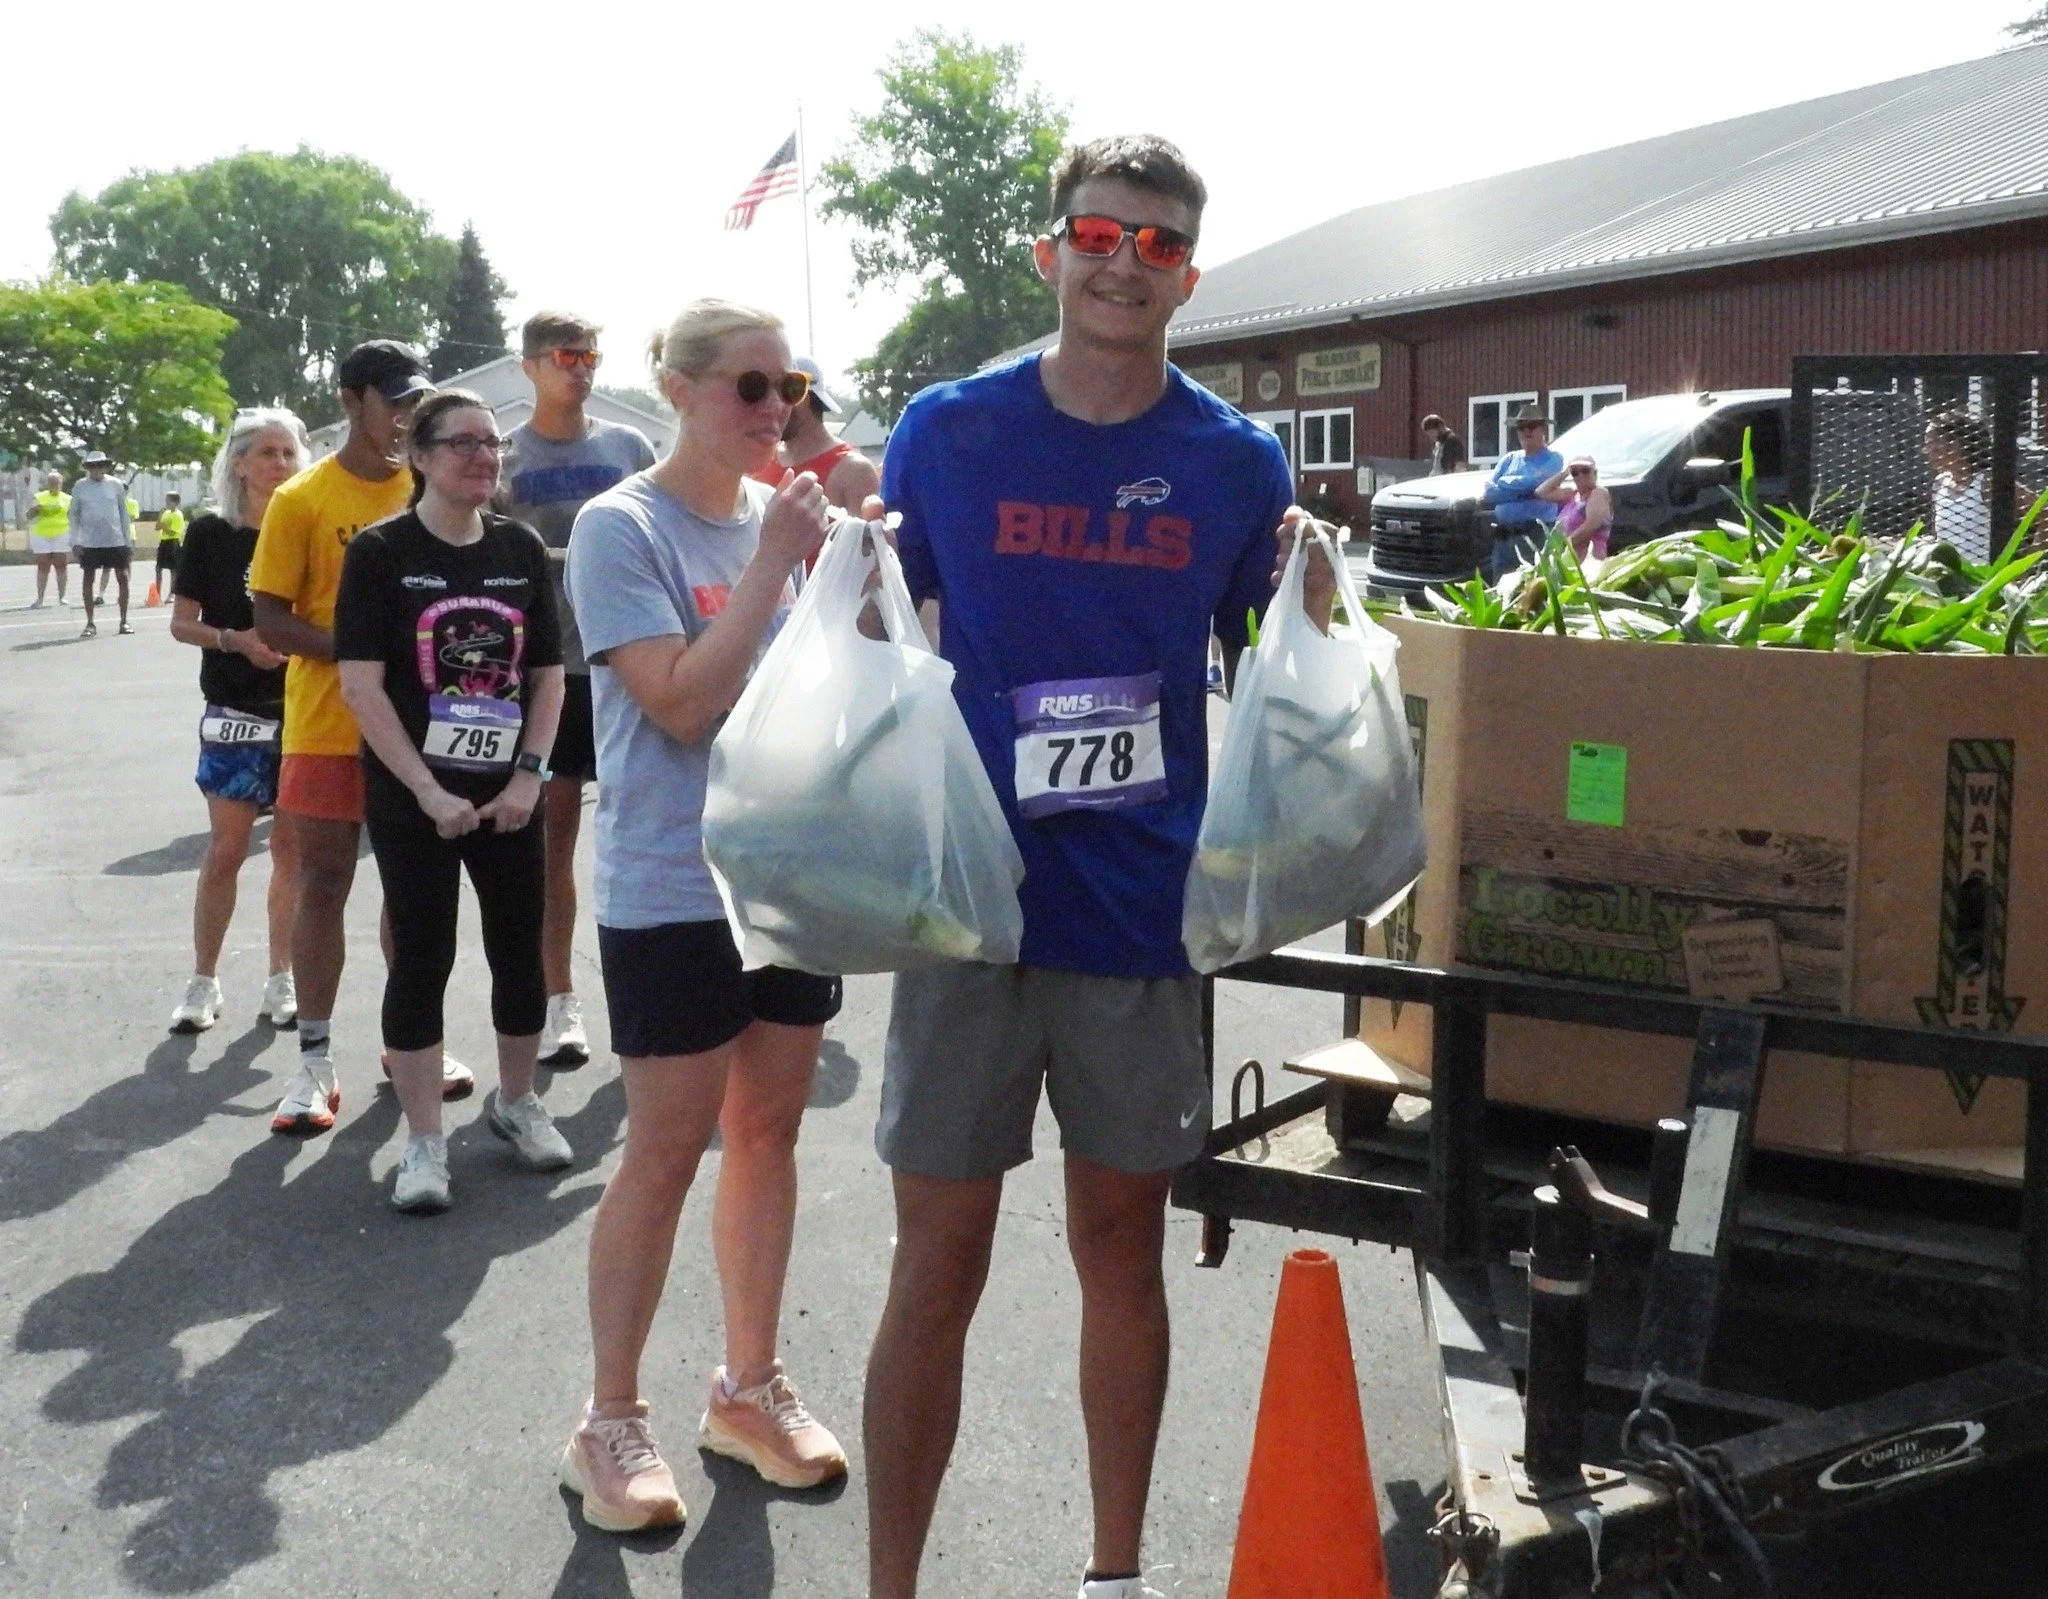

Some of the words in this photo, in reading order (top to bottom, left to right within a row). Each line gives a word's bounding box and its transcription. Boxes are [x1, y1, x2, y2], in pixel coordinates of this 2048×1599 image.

[994, 501, 1193, 571] BILLS
[1038, 693, 1093, 716] RMS
[446, 727, 502, 759] 795
[1047, 731, 1135, 788] 778
[1469, 865, 1702, 949] Locally
[1466, 916, 1667, 981] Grown
